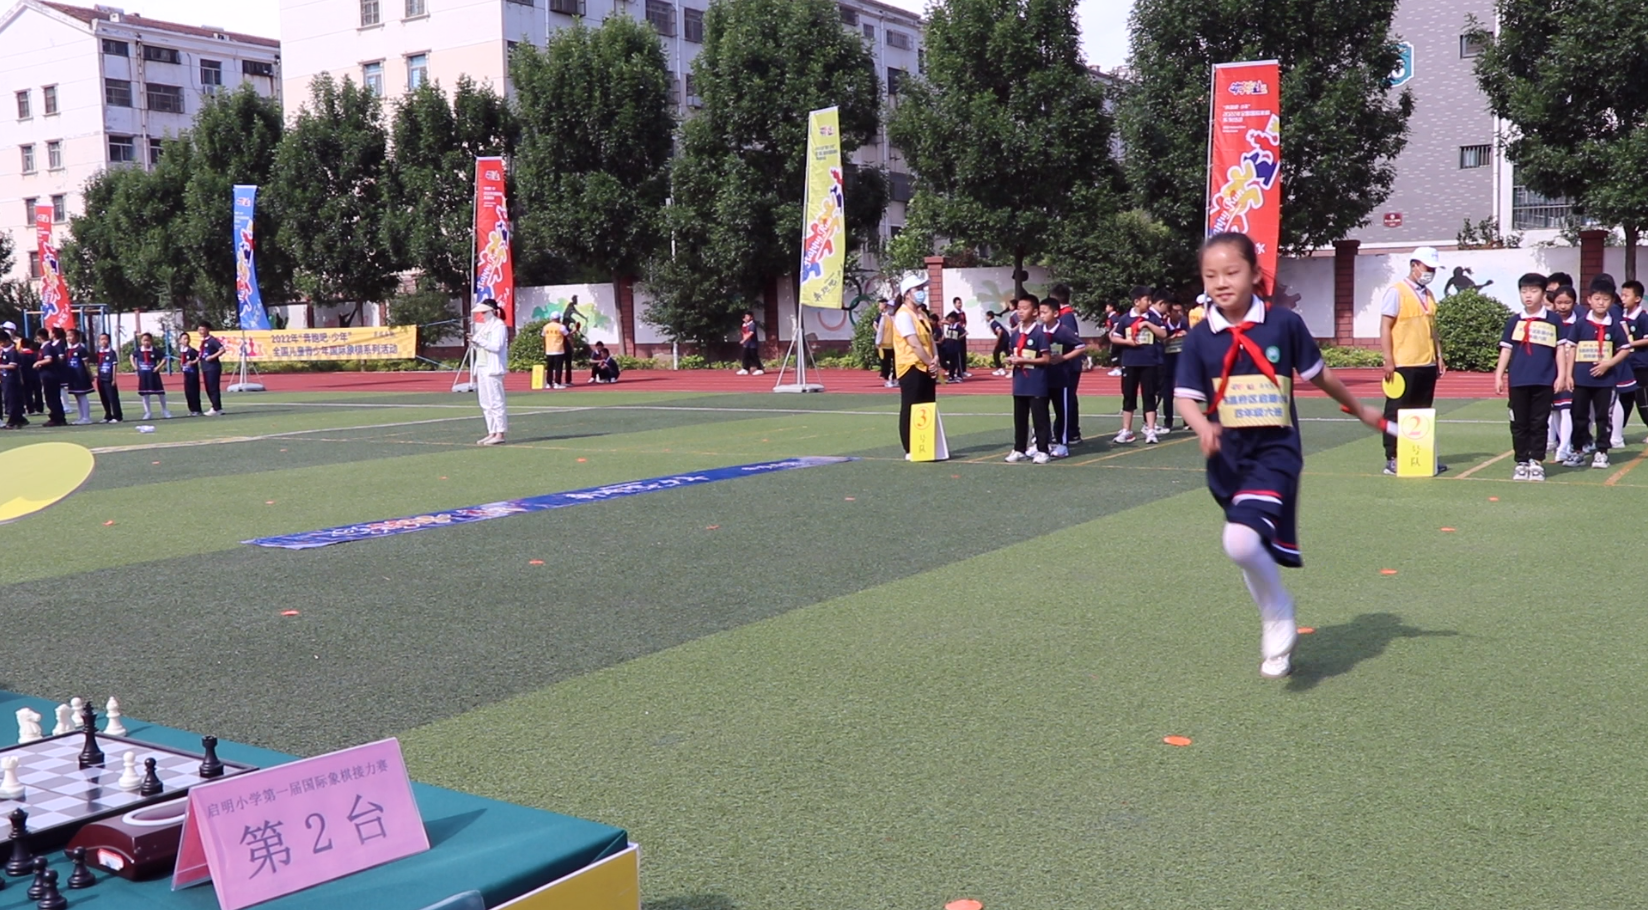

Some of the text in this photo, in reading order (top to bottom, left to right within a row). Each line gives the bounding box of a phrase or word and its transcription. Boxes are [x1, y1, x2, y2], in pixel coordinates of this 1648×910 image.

[917, 408, 927, 427] 3
[1408, 415, 1421, 436] 2
[206, 757, 388, 819] 启明小学第一届国际象棋接力赛
